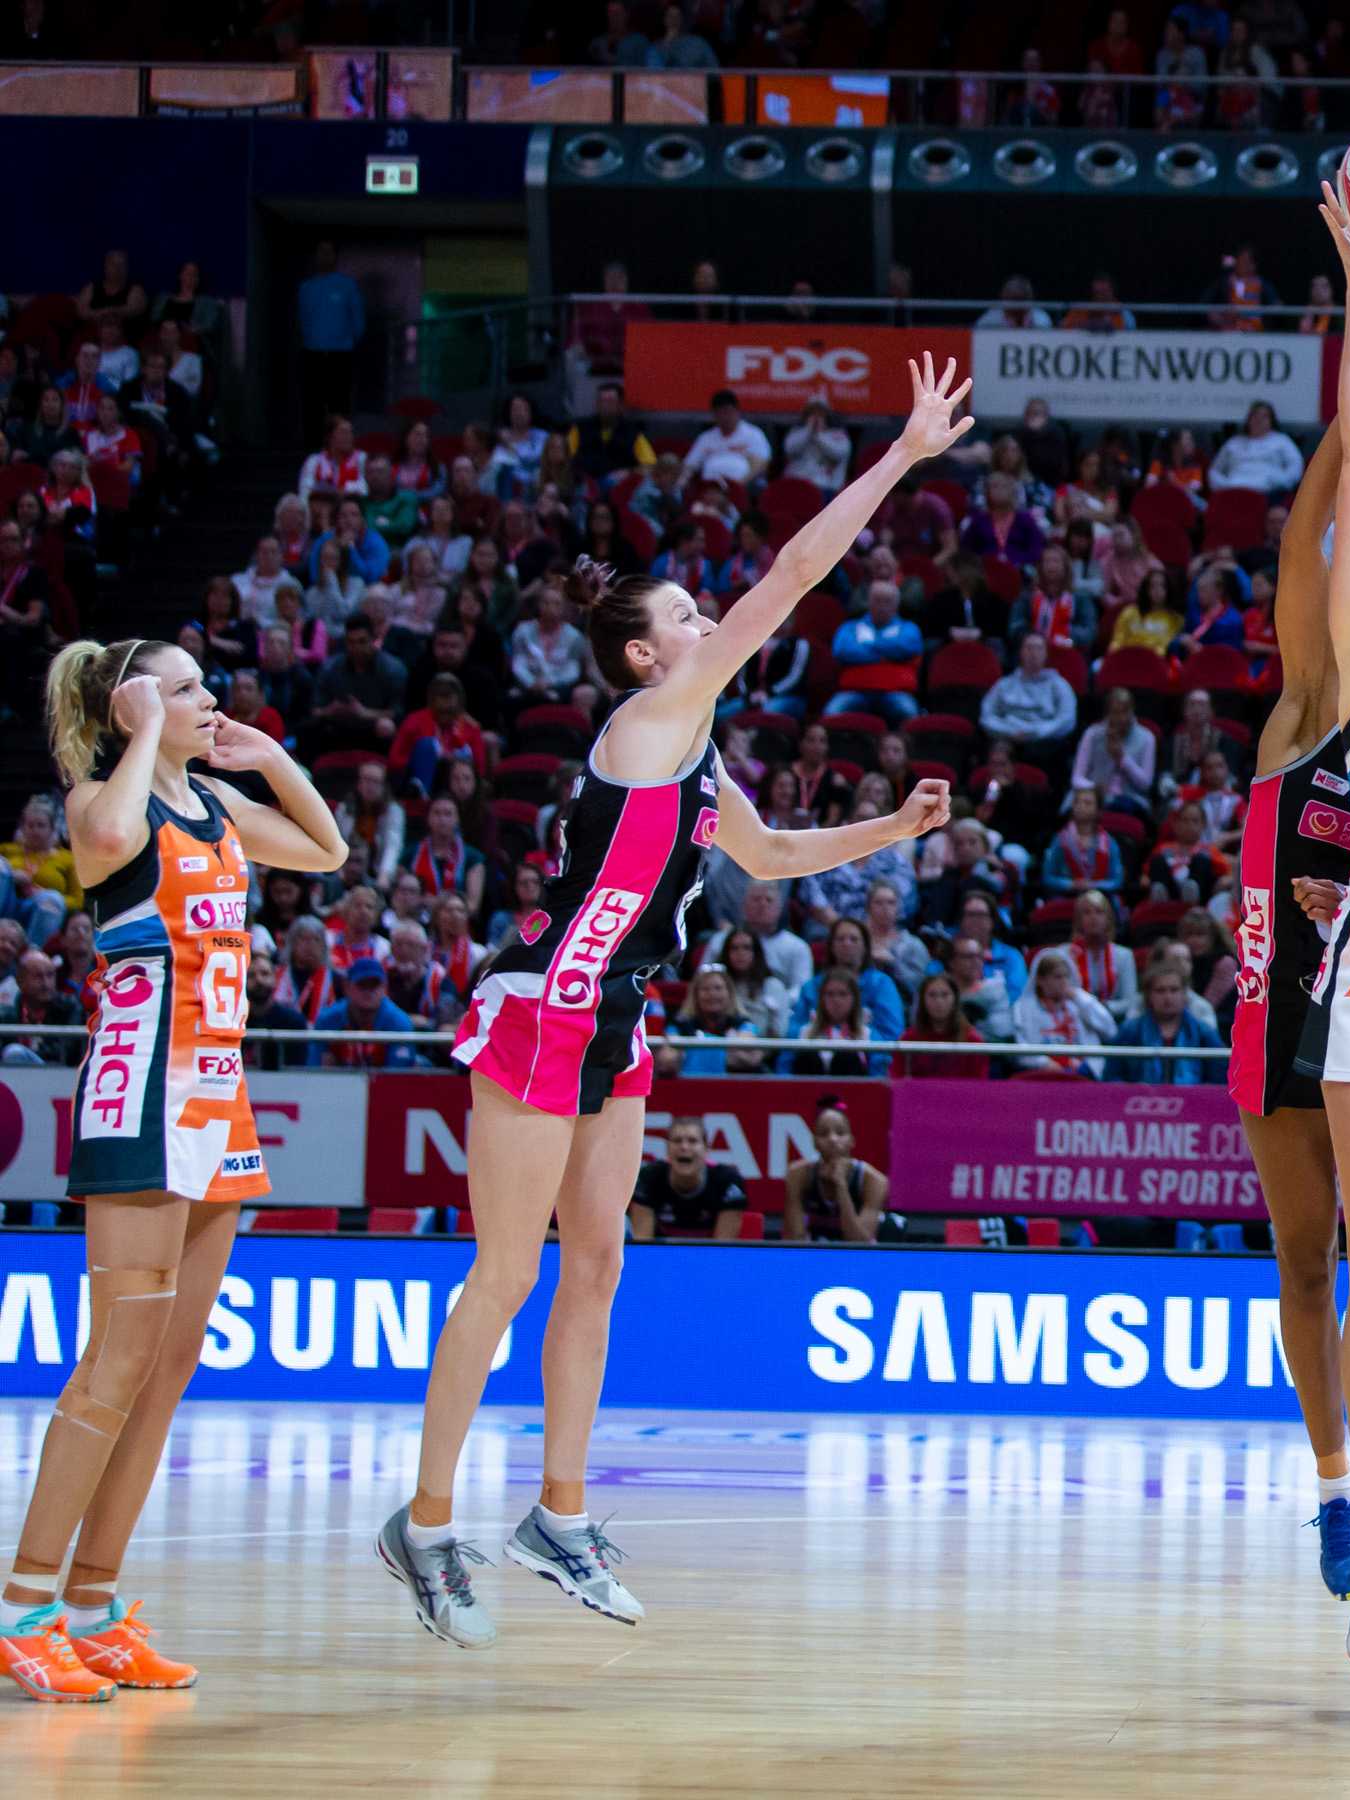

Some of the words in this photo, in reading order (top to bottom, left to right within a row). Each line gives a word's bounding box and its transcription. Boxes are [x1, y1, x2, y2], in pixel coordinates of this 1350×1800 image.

[726, 346, 870, 381] FDC
[999, 345, 1292, 383] BROKENWOOD
[213, 936, 244, 948] NISS
[572, 891, 629, 964] HCF
[1244, 890, 1266, 960] HCF
[91, 1020, 139, 1129] HCF
[404, 1108, 822, 1180] NAN
[1035, 1119, 1250, 1161] LORNAJANE.CO
[952, 1164, 984, 1199] #1
[991, 1166, 1129, 1204] NETBALL
[1137, 1168, 1259, 1206] SPORTS
[0, 1272, 513, 1373] ASUN
[808, 1286, 1347, 1389] SAMSUN
